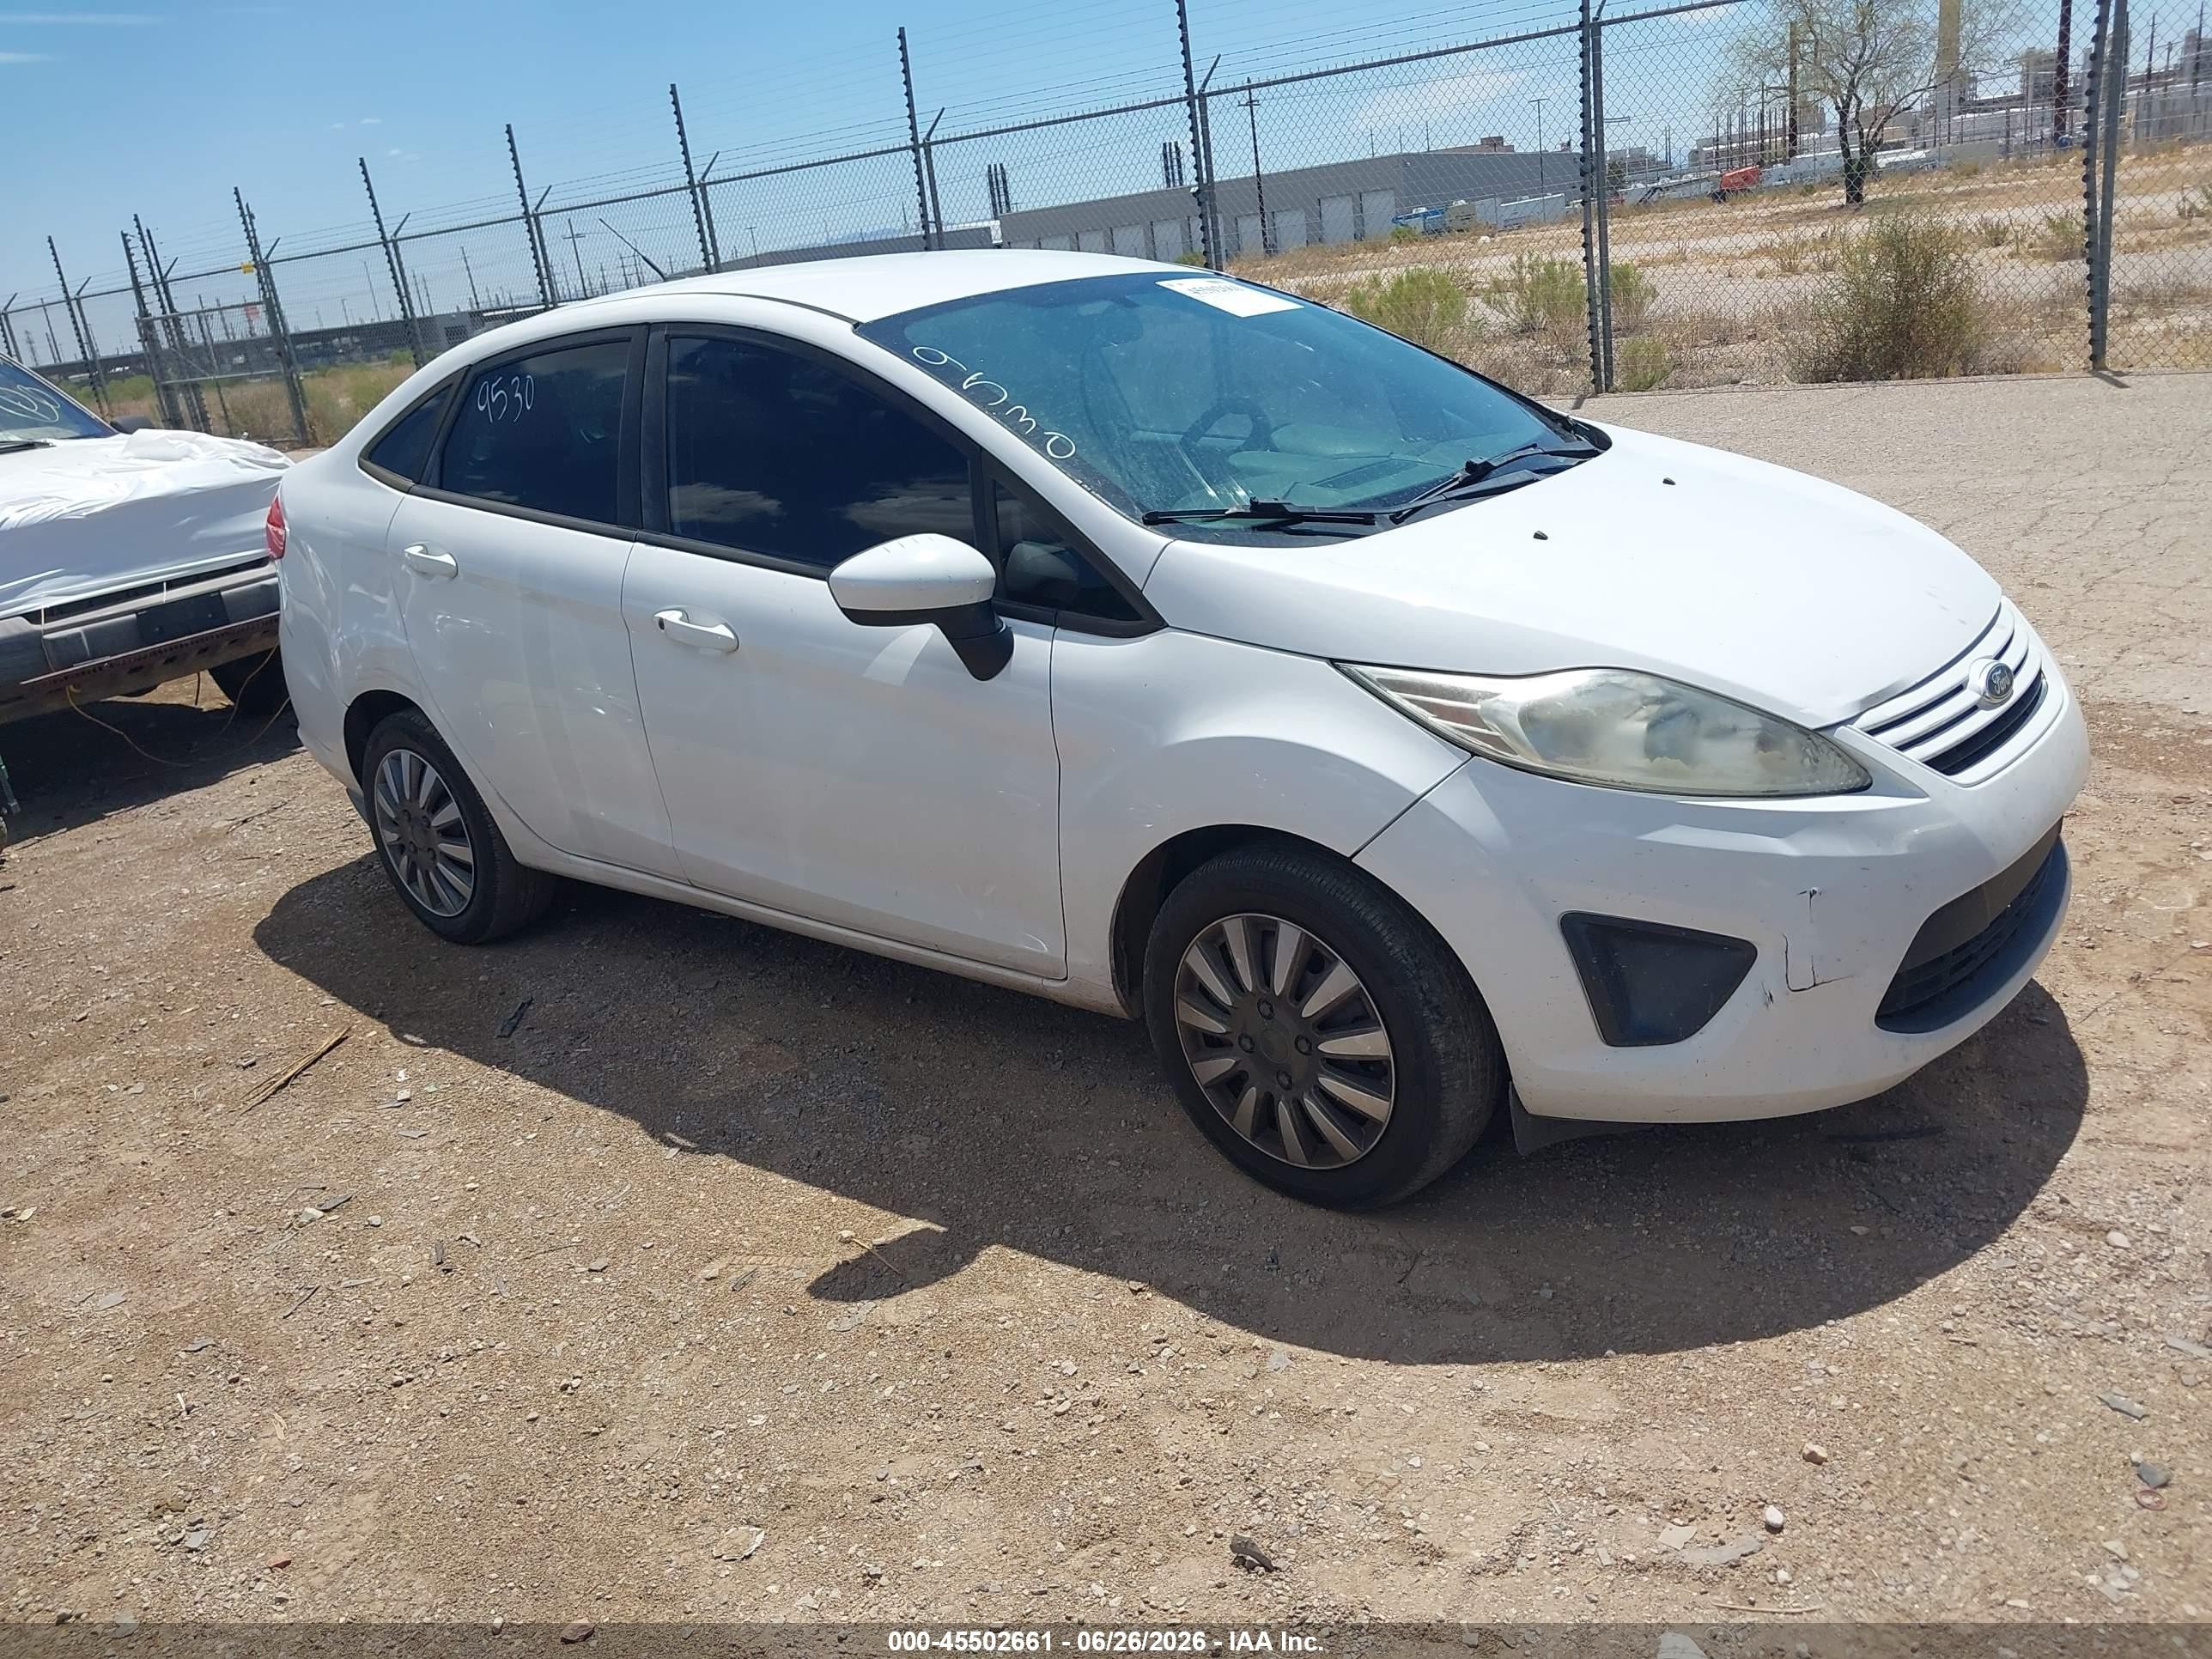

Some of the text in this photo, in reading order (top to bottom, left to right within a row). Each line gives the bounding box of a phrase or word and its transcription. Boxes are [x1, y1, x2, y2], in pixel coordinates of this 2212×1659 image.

[477, 374, 535, 423] 9530
[912, 346, 1076, 459] 9530
[1991, 667, 2011, 694] Ford
